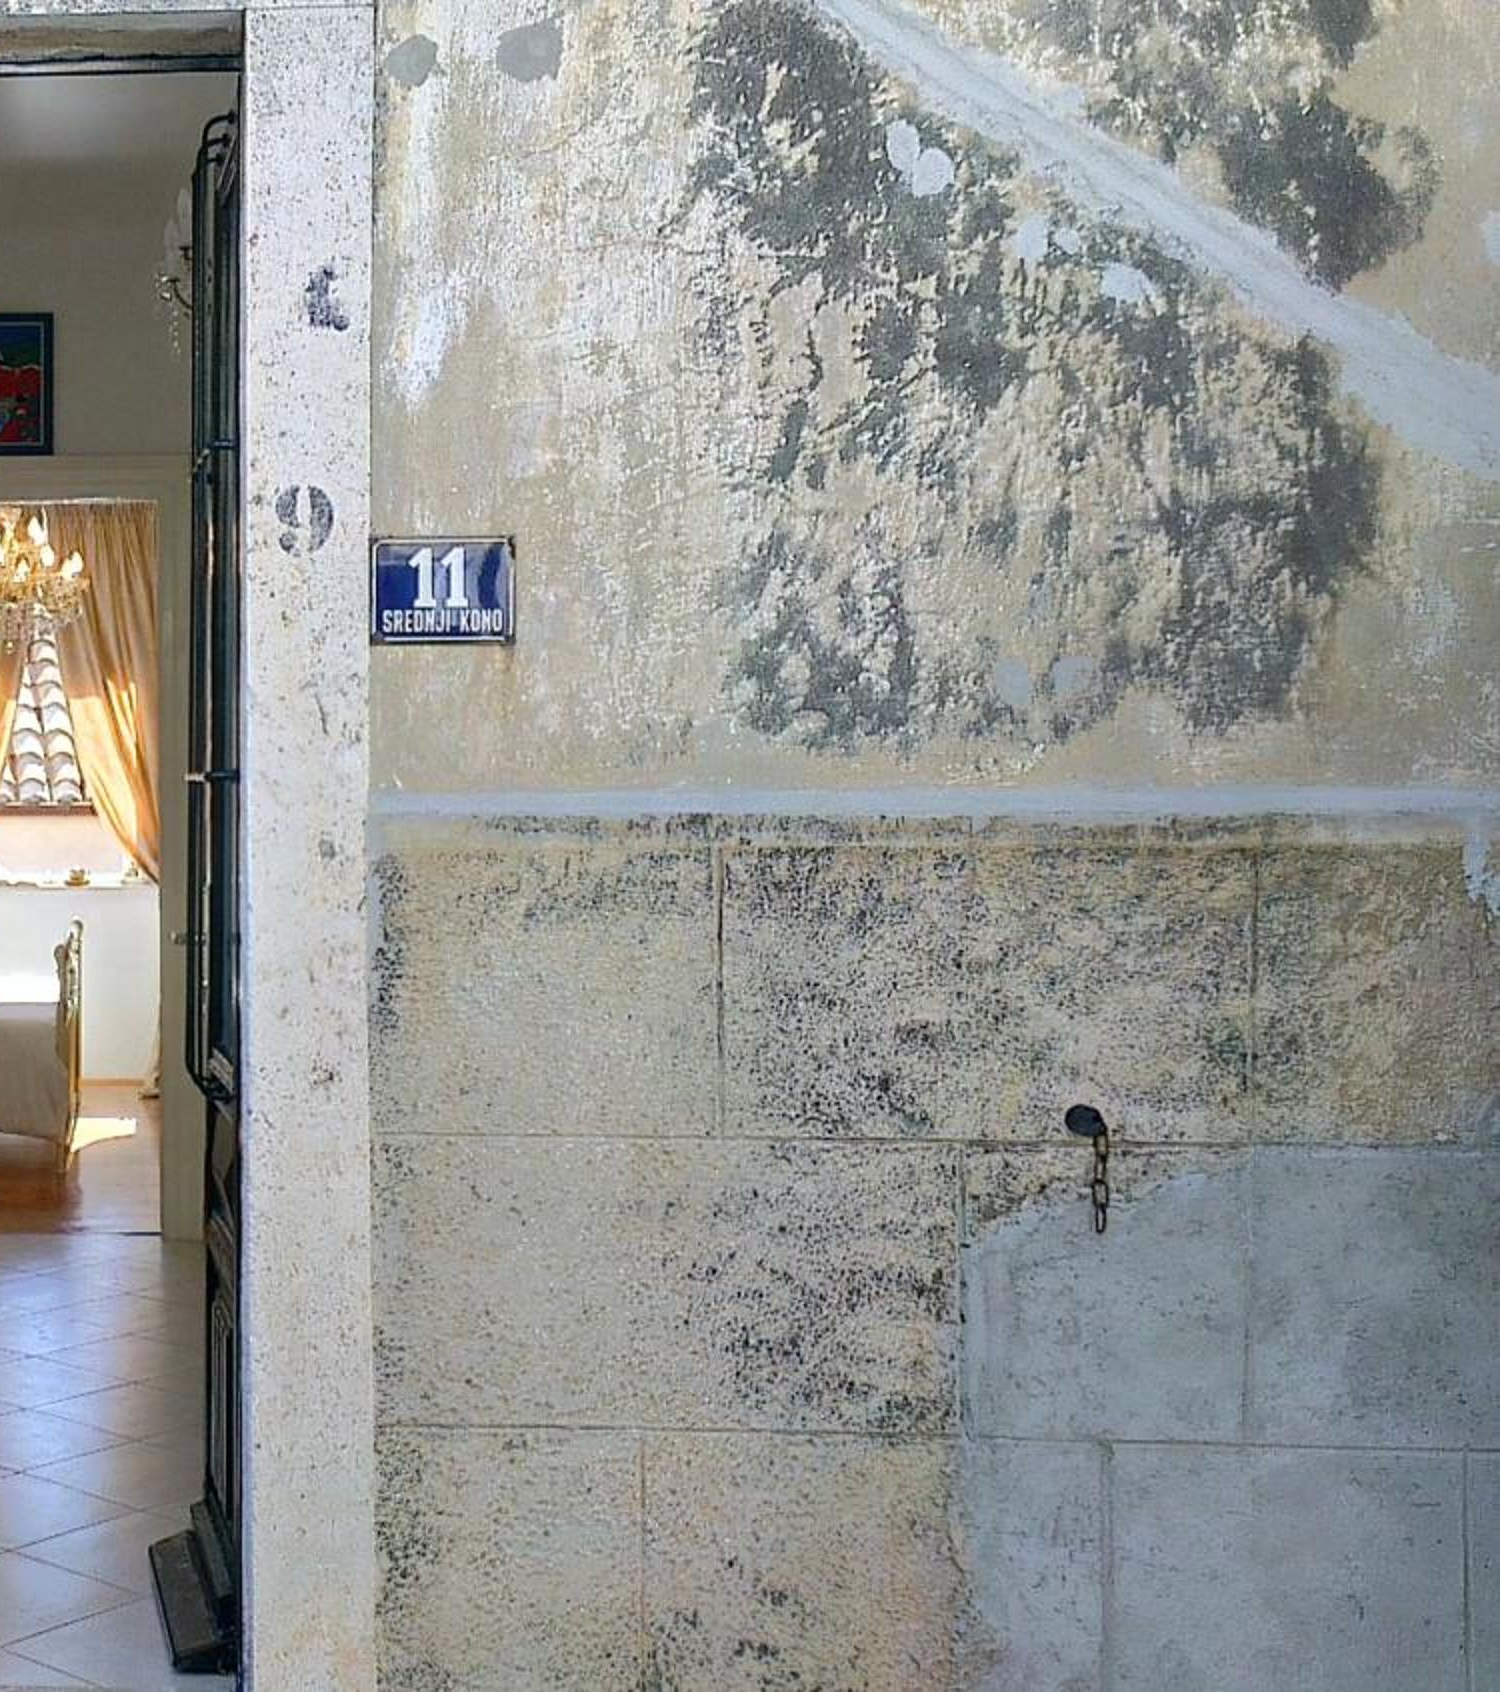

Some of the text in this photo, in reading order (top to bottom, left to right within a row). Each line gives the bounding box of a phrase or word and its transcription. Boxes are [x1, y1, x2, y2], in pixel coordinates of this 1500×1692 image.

[408, 547, 469, 608] 11
[382, 609, 503, 633] SREDNJI KONO
